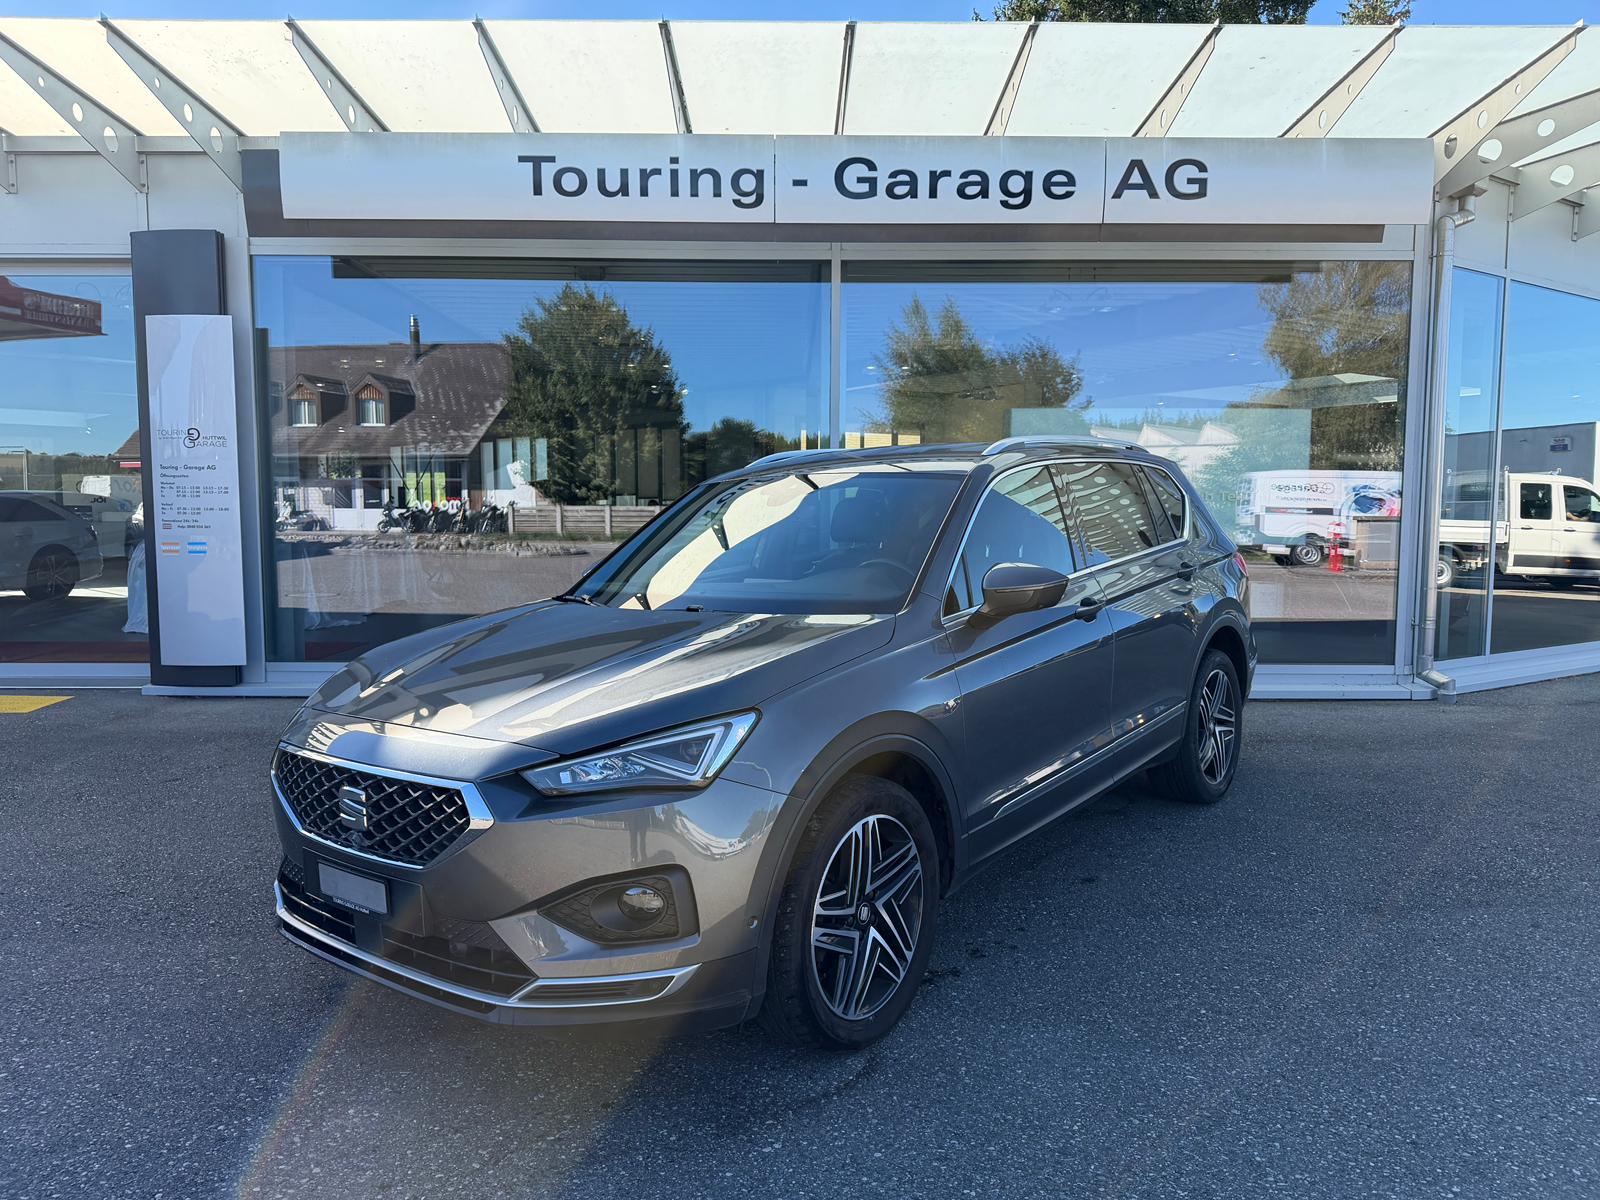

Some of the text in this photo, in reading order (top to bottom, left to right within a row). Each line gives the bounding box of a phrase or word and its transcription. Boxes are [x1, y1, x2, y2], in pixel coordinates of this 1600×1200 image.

[518, 156, 1209, 210] Touring - Garage AG
